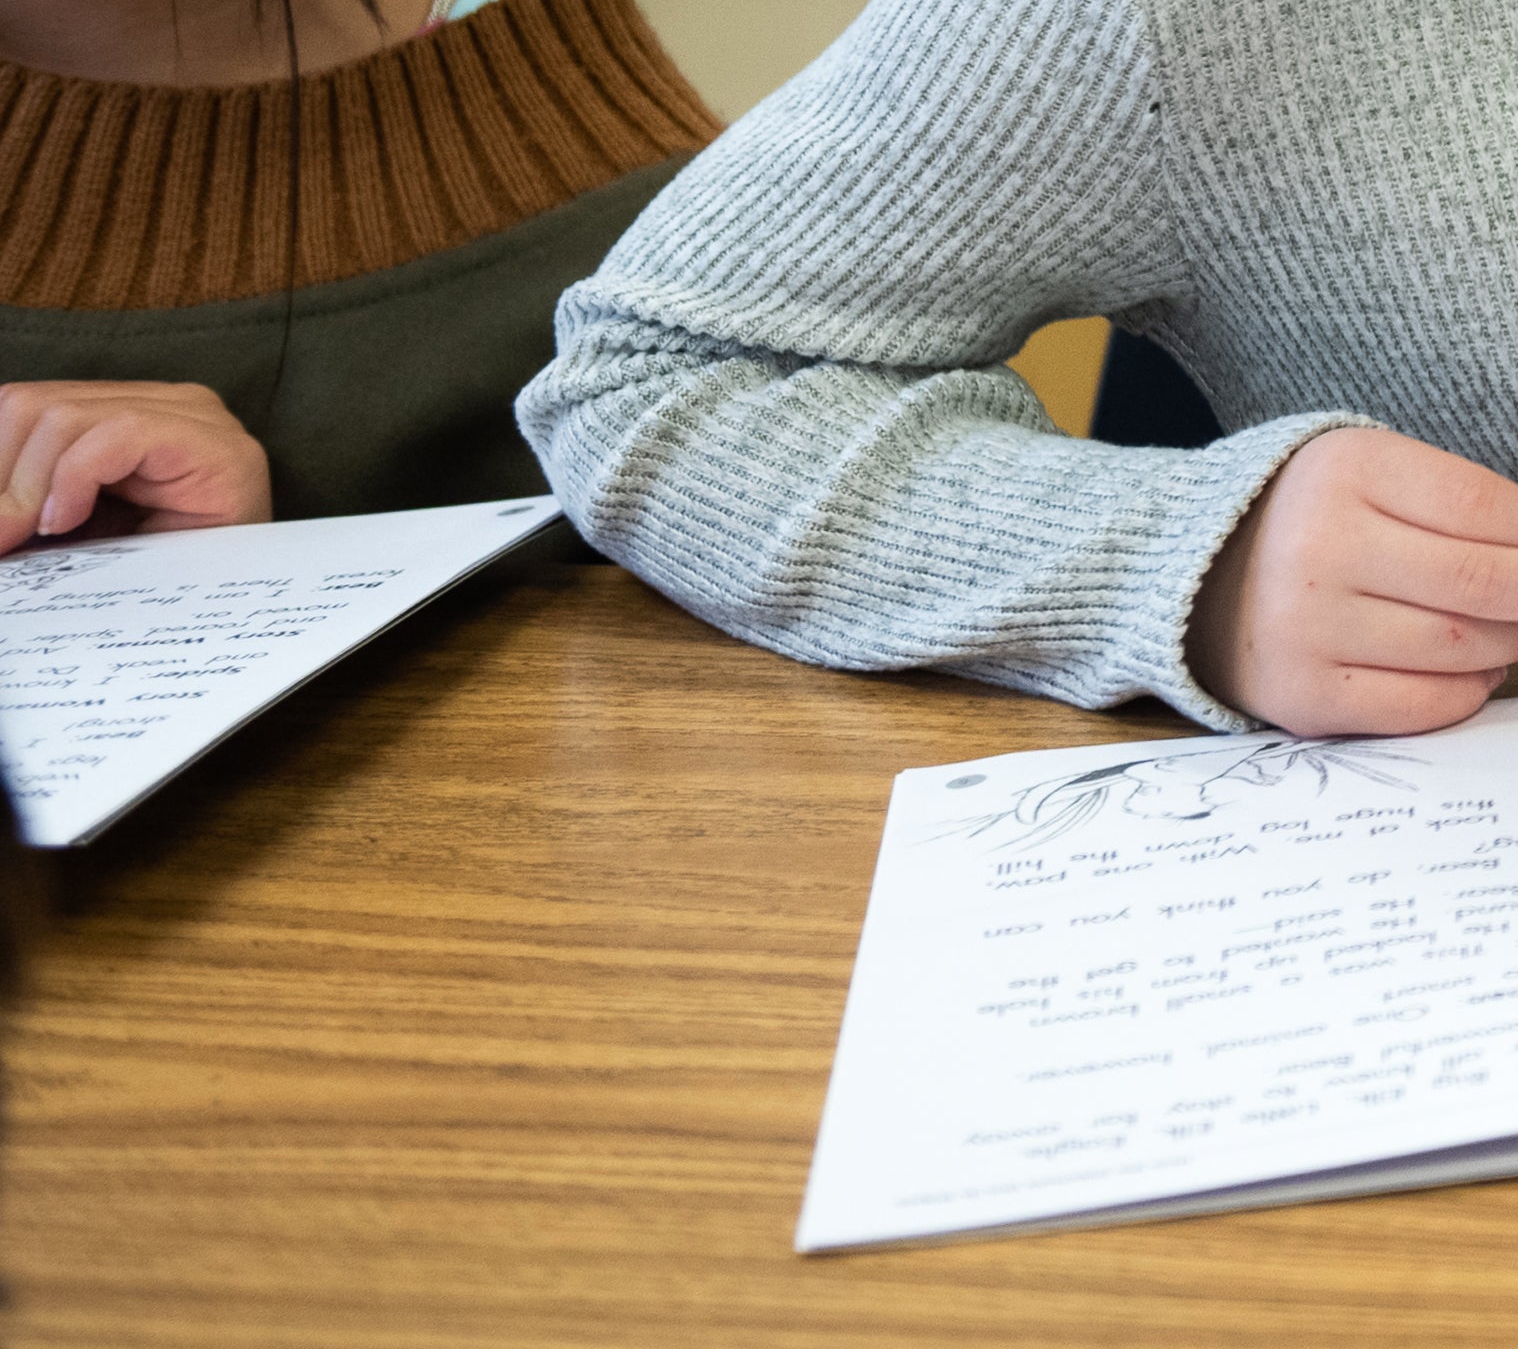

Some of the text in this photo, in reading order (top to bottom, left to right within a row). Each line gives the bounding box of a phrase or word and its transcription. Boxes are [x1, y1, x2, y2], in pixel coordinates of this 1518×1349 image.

[9, 568, 403, 606] forest. There is nothing I
[0, 580, 382, 614] Bear: I am the stronges
[189, 601, 348, 618] moved on.
[264, 614, 326, 628] and
[0, 629, 304, 656] Story Woman: And
[28, 627, 122, 643] Spider
[35, 651, 268, 675] and weak. Do
[143, 664, 245, 678] Spider:
[99, 675, 116, 685] I
[127, 690, 204, 701] Story
[63, 714, 168, 731] strong!
[19, 729, 146, 748] Bear: I
[1441, 798, 1494, 810] this
[1336, 805, 1414, 821] huge
[1260, 819, 1308, 832] log
[1370, 824, 1398, 836] at
[1426, 813, 1497, 831] Look
[1145, 832, 1233, 852] down
[1287, 829, 1341, 843] me.
[1070, 849, 1117, 862] the
[1180, 843, 1257, 863] With
[990, 858, 1042, 875] hill.
[1093, 861, 1152, 876] one
[1418, 857, 1499, 872] Bear,
[987, 869, 1065, 889] paw,
[1348, 869, 1390, 885] do
[1263, 877, 1319, 898] you
[1158, 896, 1235, 918] think
[1370, 896, 1414, 911] He
[1070, 906, 1128, 926] you
[1370, 914, 1416, 929] He
[984, 922, 1042, 938] can
[1463, 920, 1509, 935] He
[1221, 926, 1343, 961] wanted
[1324, 930, 1436, 962] looked
[1422, 942, 1482, 959] This
[1163, 953, 1194, 966] to
[1255, 954, 1297, 970] up
[1329, 956, 1395, 976] was
[1085, 960, 1136, 981] get
[1151, 968, 1227, 988] from
[1008, 974, 1058, 989] the
[1281, 975, 1301, 985] a
[1077, 985, 1123, 999] his
[1166, 983, 1251, 1011] small
[977, 996, 1049, 1016] hole
[1030, 1001, 1139, 1027] brown
